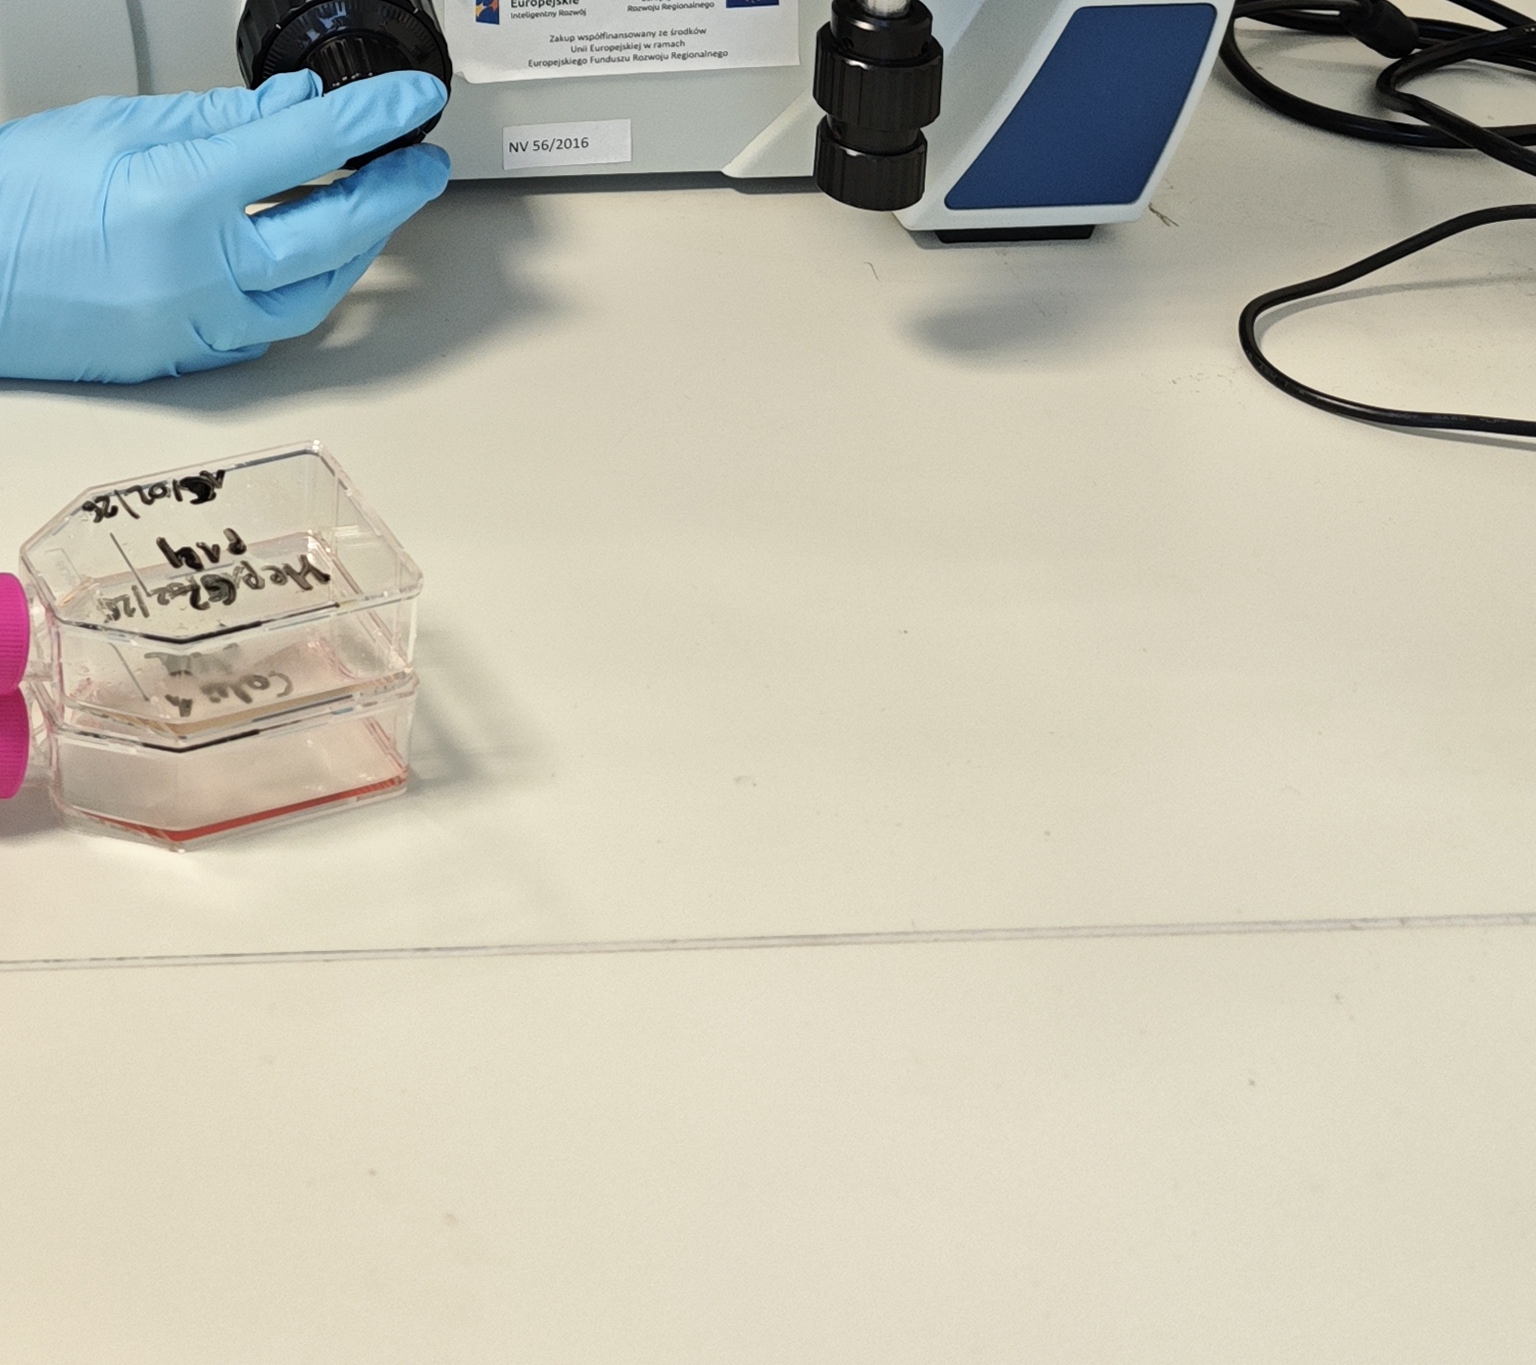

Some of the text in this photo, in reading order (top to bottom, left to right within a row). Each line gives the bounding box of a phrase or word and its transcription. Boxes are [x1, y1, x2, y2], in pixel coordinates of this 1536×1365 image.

[627, 1, 715, 12] Rozwoju Regionalnego
[510, 10, 557, 19] Inteligentny
[549, 34, 575, 43] Zakup
[577, 30, 656, 42] współfinansowany
[670, 27, 707, 36] środków
[570, 45, 588, 53] Unii
[590, 42, 641, 53] Europejskiej
[653, 40, 686, 49] ramach
[528, 49, 728, 68] Europejskiego Funduszu Rozwoju Regionalnego
[509, 136, 589, 153] NV 56/2016
